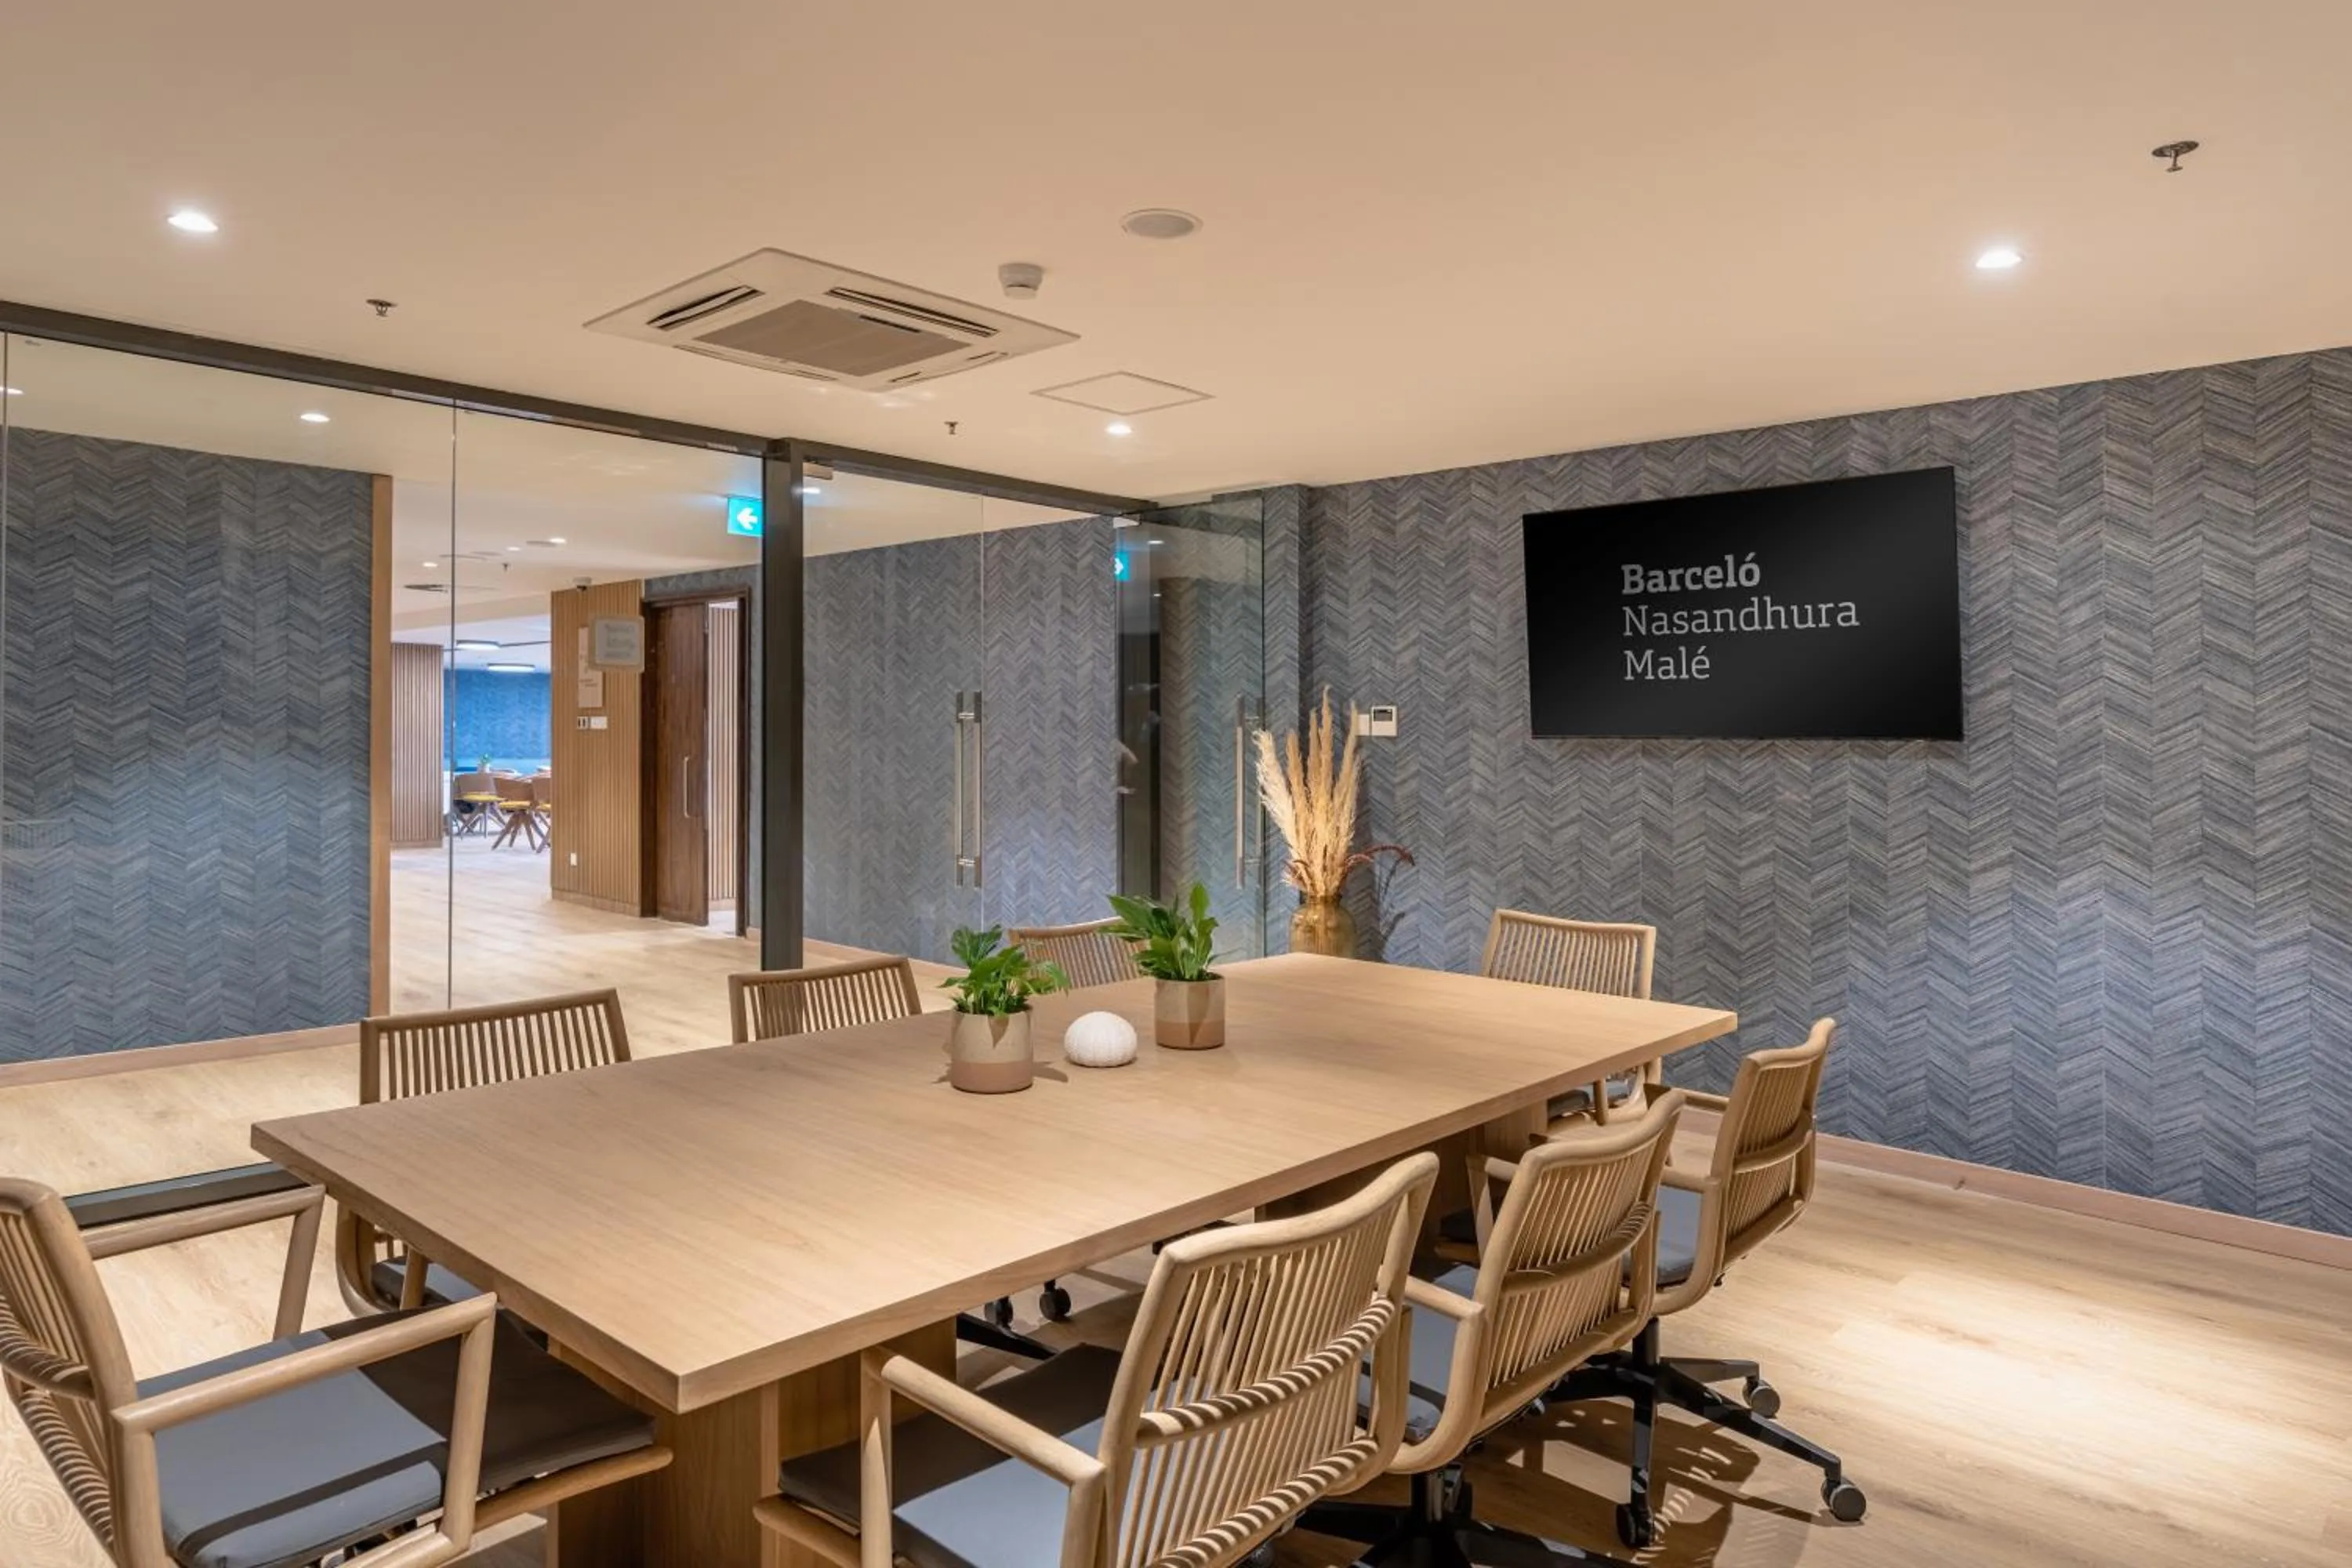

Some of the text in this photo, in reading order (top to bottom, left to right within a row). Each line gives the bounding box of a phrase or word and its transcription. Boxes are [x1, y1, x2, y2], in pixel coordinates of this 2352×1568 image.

[1622, 552, 1762, 594] Barceló
[1623, 596, 1860, 637] Nasandhura
[1624, 645, 1711, 681] Malé
